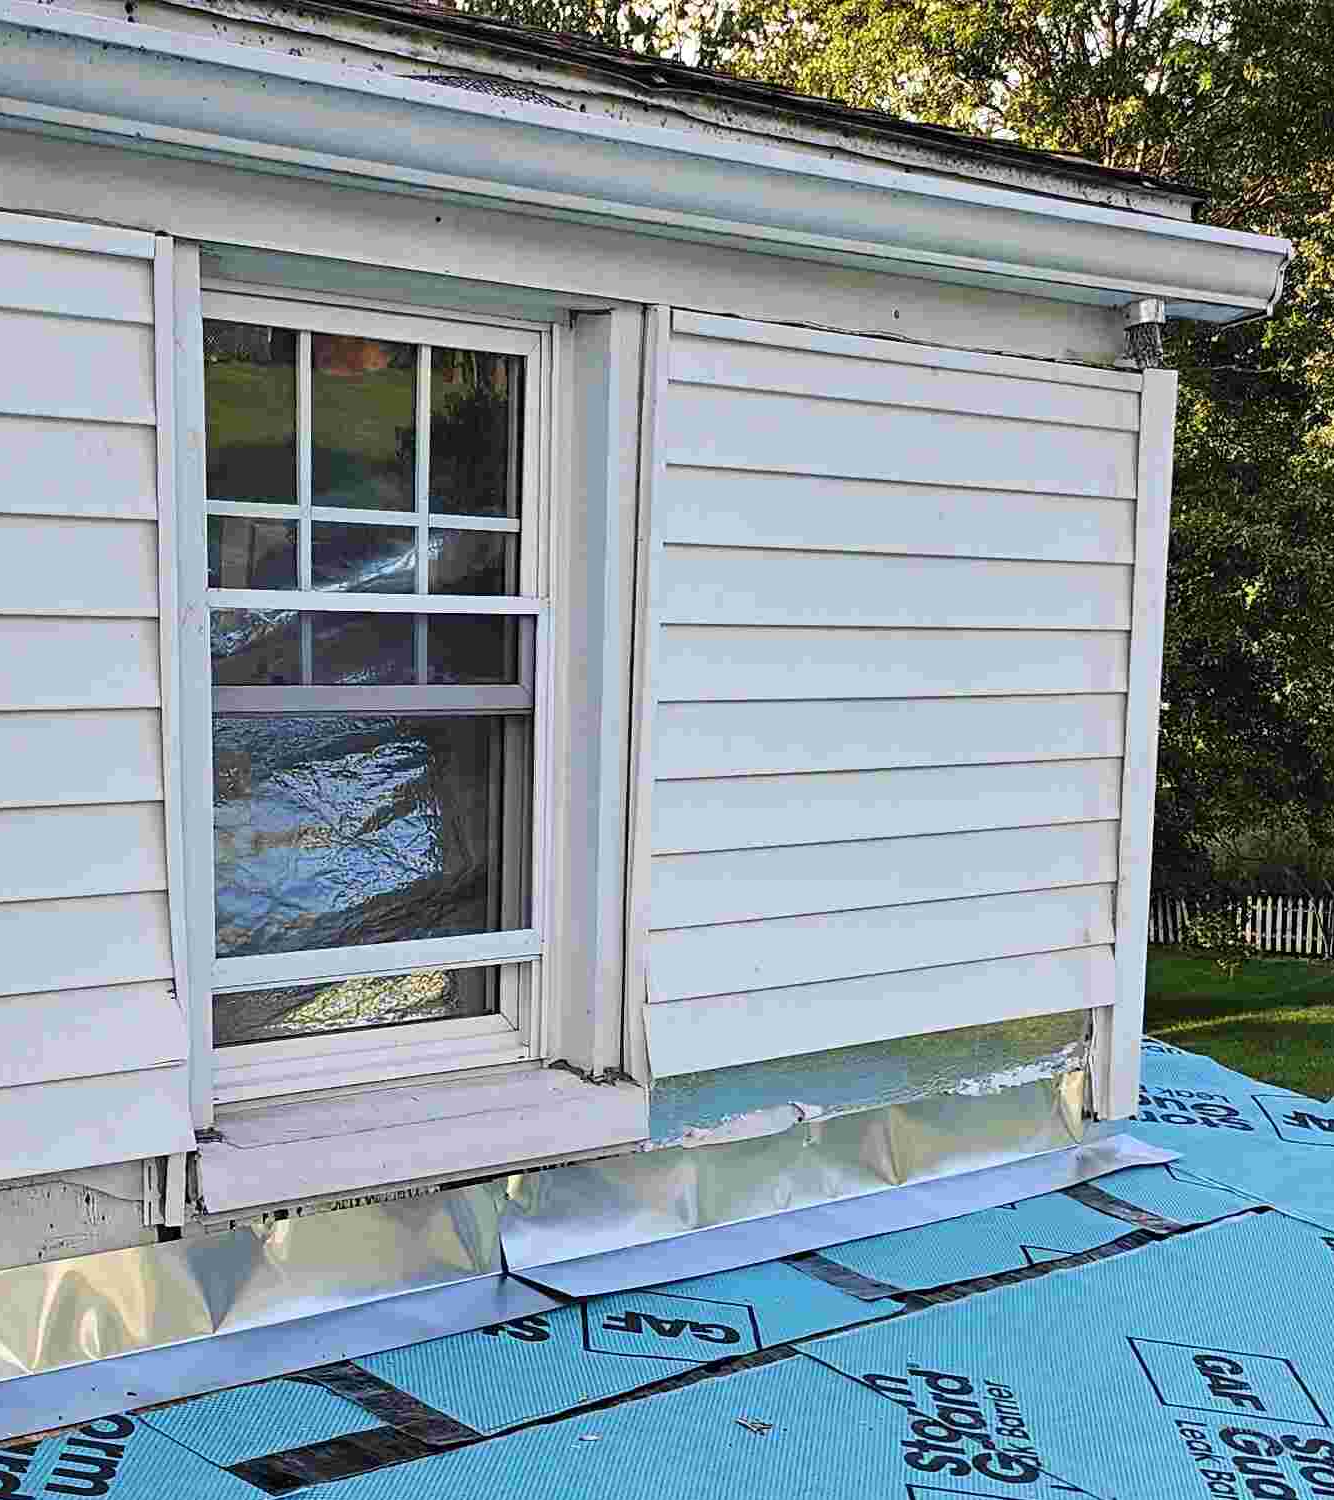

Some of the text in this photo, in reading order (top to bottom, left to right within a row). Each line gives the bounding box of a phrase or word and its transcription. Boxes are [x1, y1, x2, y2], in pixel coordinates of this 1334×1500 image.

[603, 1312, 740, 1344] GAF
[1193, 1354, 1266, 1411] GAF
[984, 1378, 1031, 1440] Barrier
[1175, 1420, 1228, 1462] Leak
